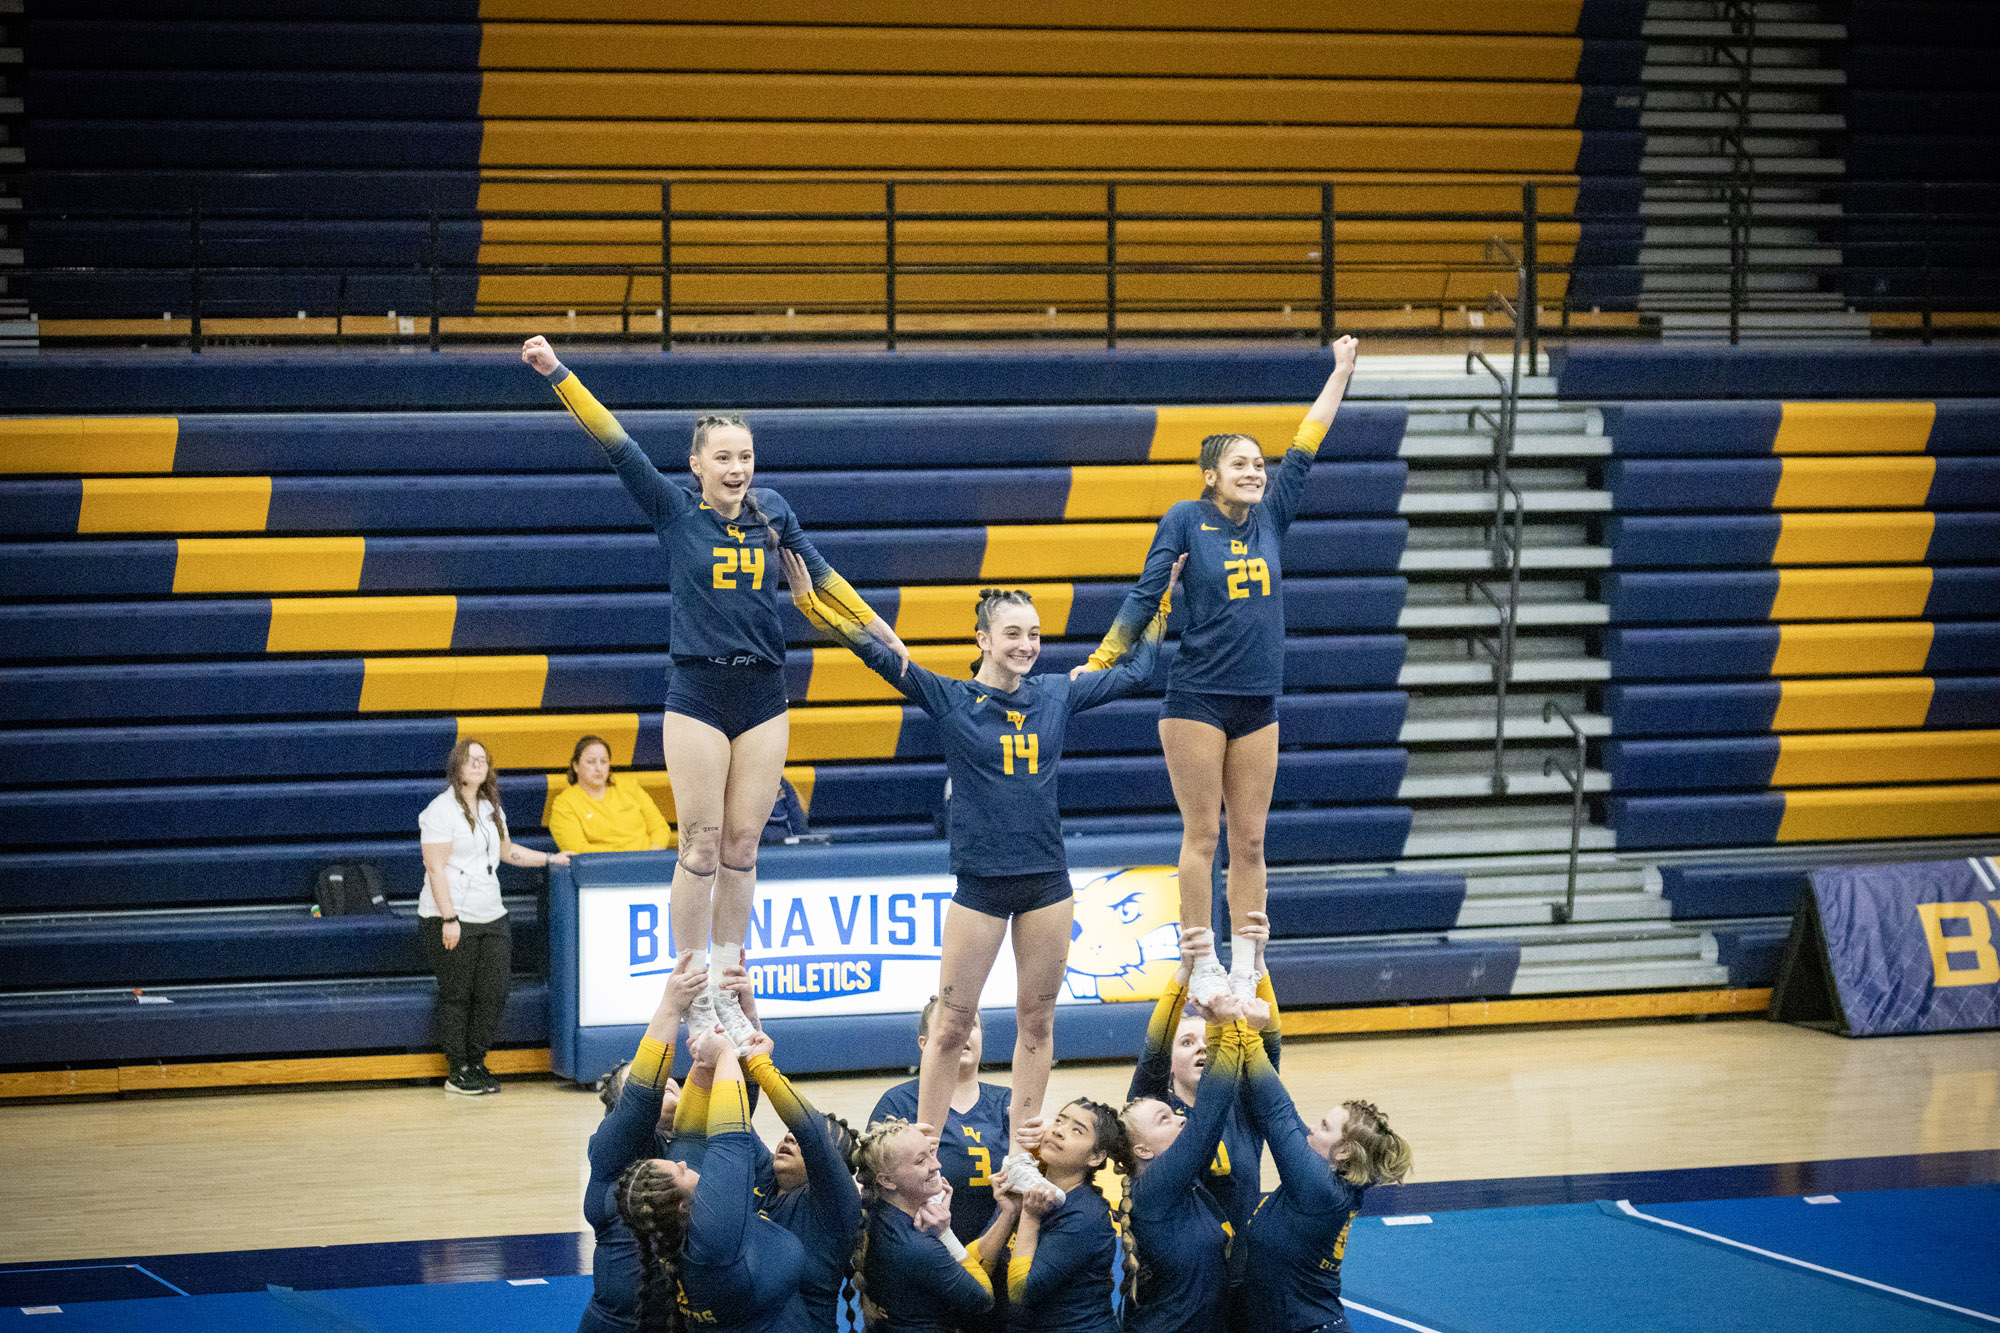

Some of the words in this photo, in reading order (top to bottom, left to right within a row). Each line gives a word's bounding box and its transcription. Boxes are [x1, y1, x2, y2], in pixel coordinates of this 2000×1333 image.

[713, 547, 765, 590] 24
[1224, 557, 1271, 600] 29
[1000, 733, 1039, 775] 14
[629, 898, 815, 966] BNA
[829, 892, 953, 947] VIST
[1916, 900, 2000, 988] B
[748, 961, 871, 994] ATHLETICS
[968, 1147, 992, 1186] 3
